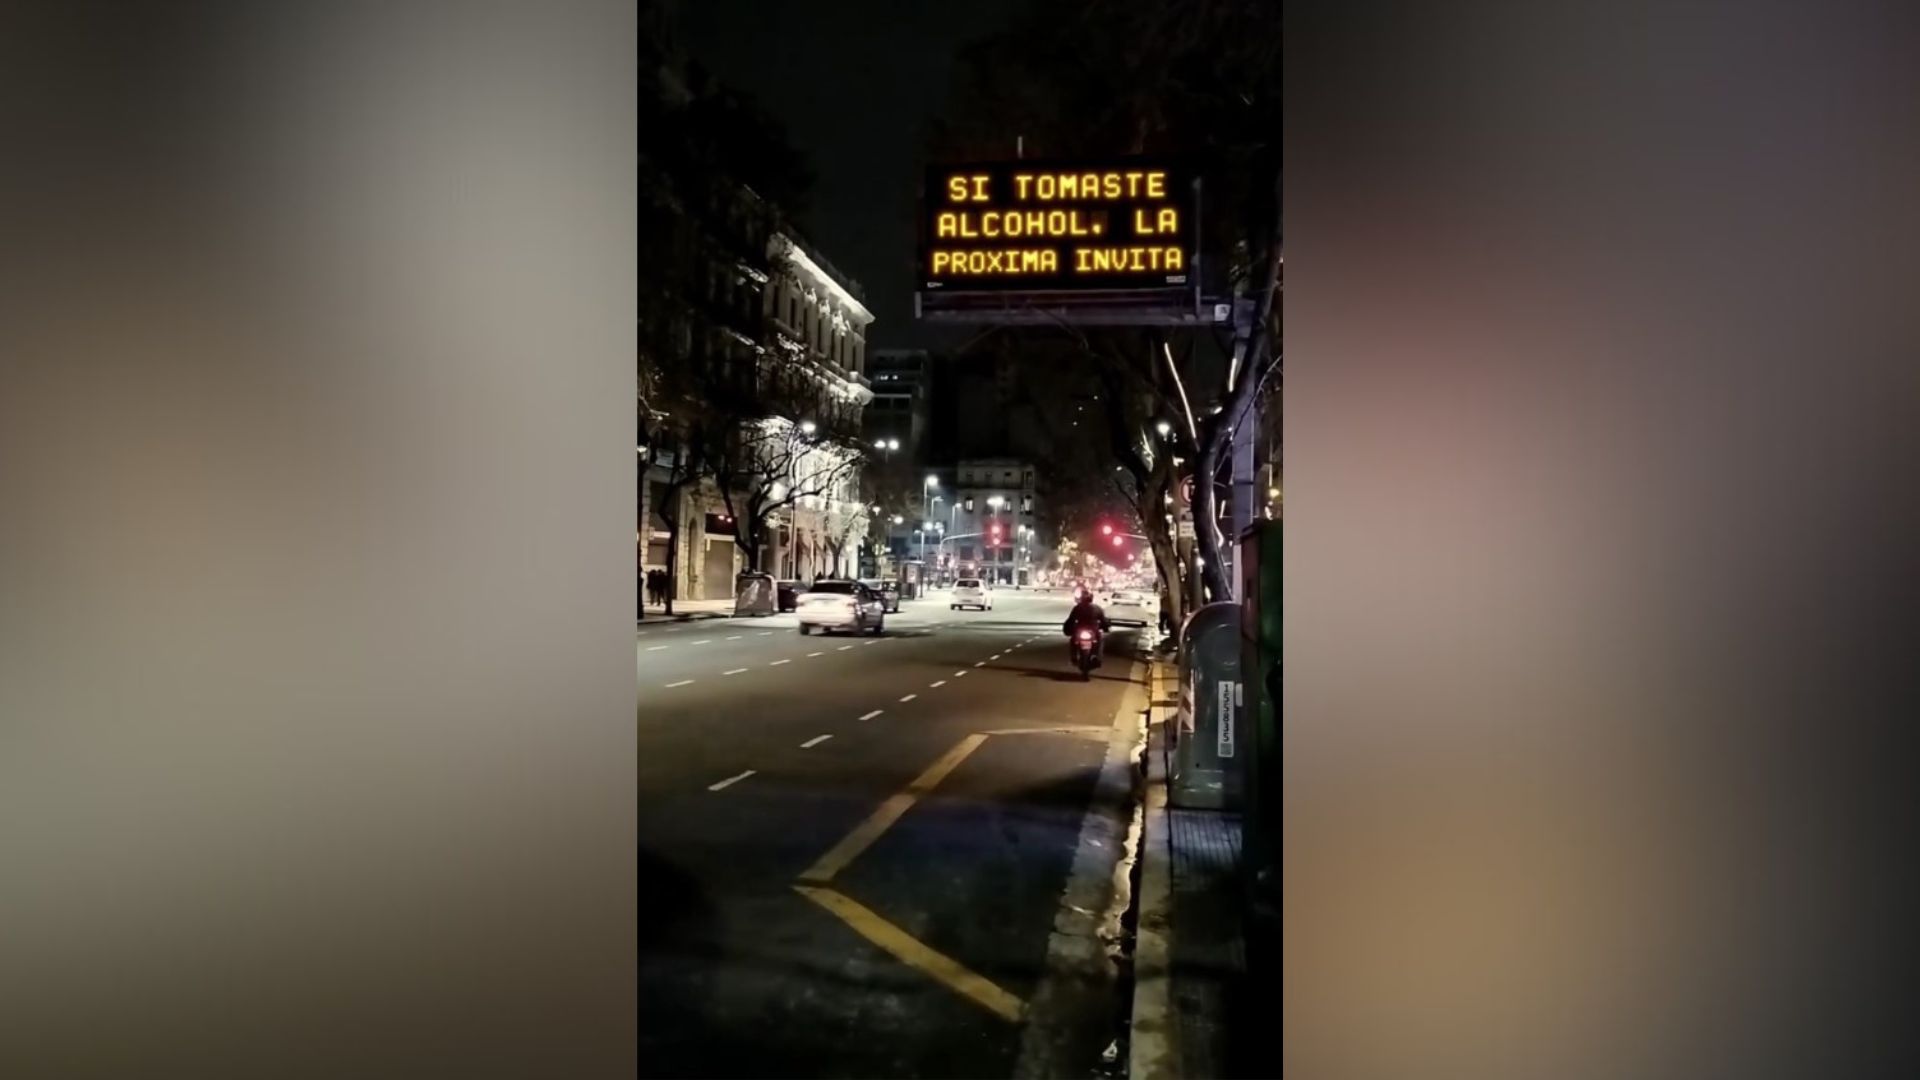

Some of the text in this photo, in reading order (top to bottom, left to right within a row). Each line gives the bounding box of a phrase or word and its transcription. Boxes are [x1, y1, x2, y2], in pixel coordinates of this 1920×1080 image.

[948, 172, 1165, 202] SI TOMASTE
[1135, 208, 1177, 234] LA
[932, 246, 1182, 274] PROXIMA INVITA
